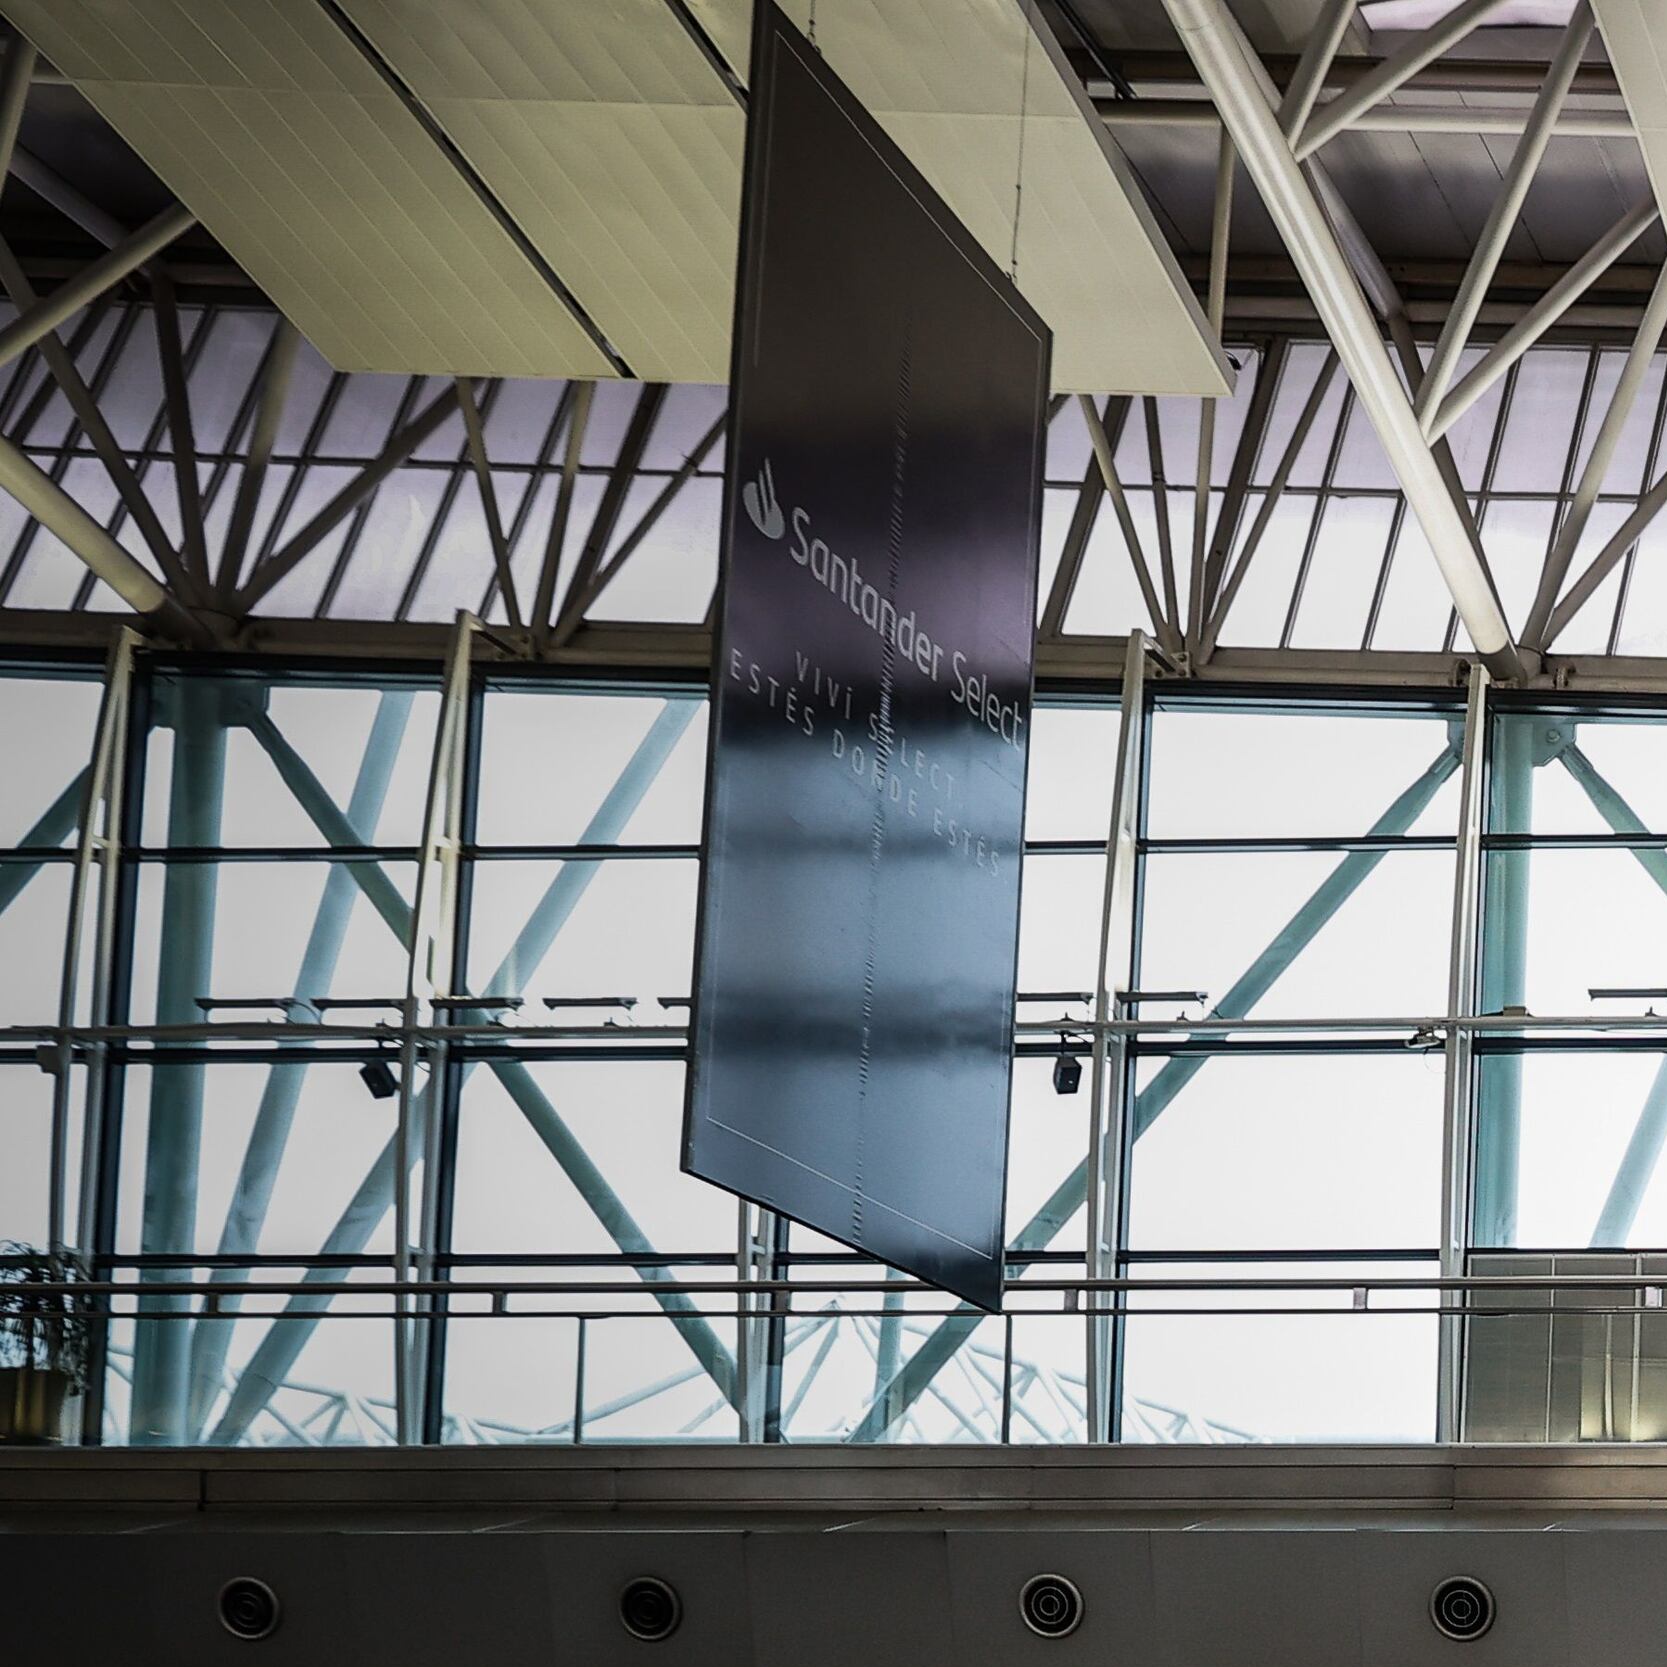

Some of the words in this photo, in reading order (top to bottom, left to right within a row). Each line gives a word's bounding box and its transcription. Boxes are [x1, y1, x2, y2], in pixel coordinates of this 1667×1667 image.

[790, 506, 944, 683] Santander
[949, 649, 1023, 753] Select
[730, 647, 815, 737] ESTÉS
[932, 808, 1000, 878] ESTÉS
